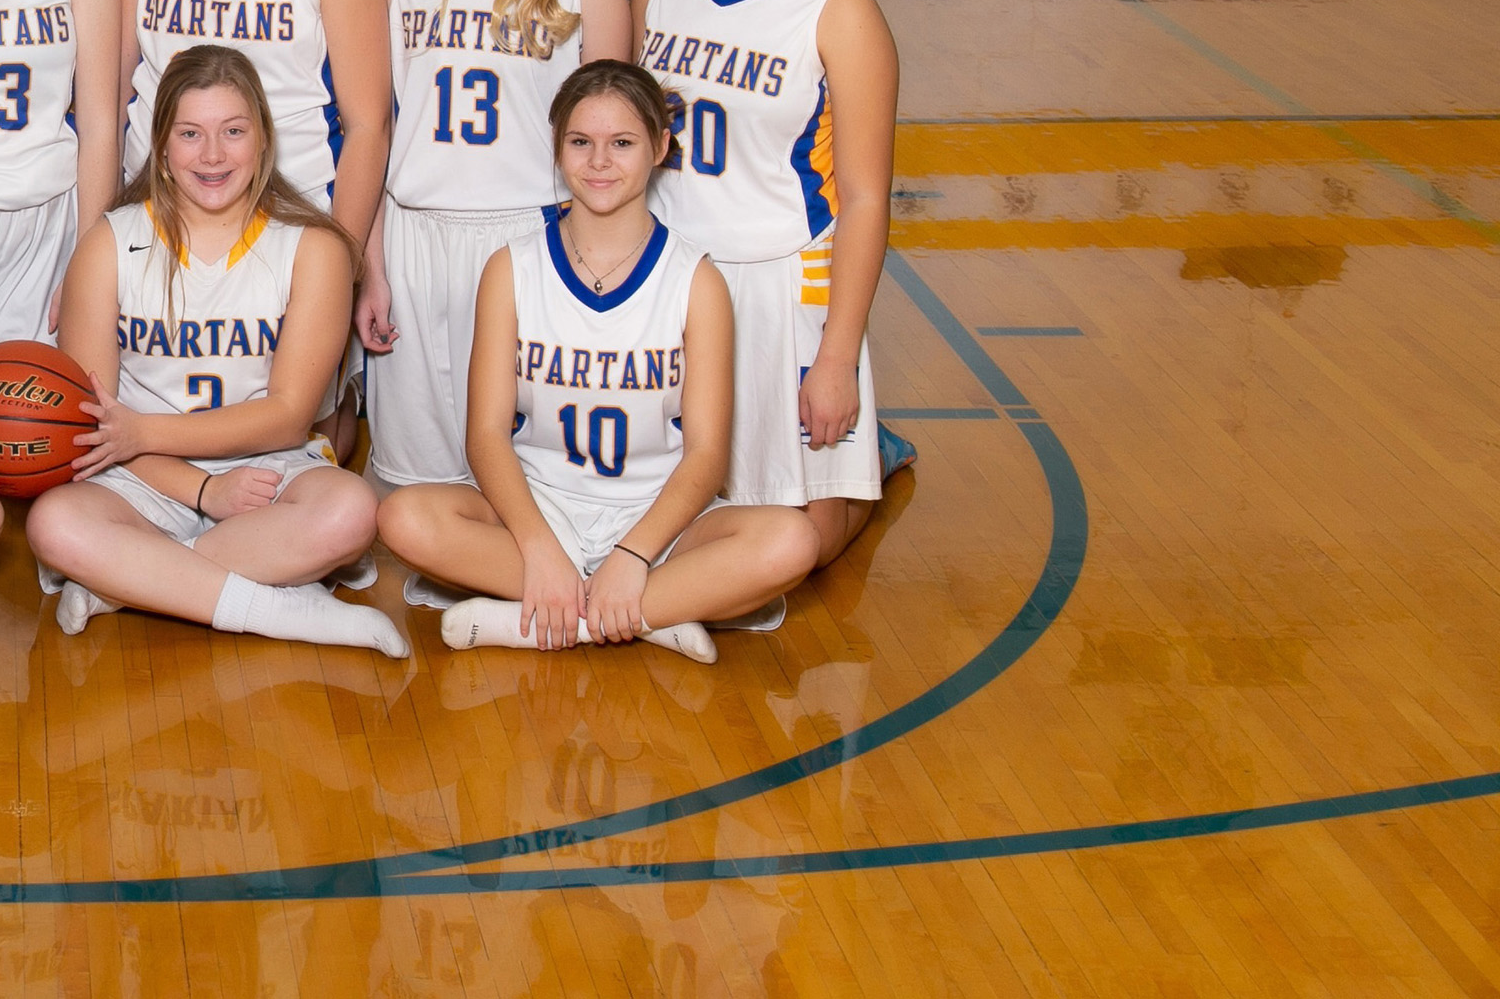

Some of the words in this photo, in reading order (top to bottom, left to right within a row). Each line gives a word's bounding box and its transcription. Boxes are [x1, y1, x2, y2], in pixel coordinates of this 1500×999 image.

[402, 8, 555, 61] SPART
[432, 64, 500, 146] 13
[557, 403, 630, 478] 10
